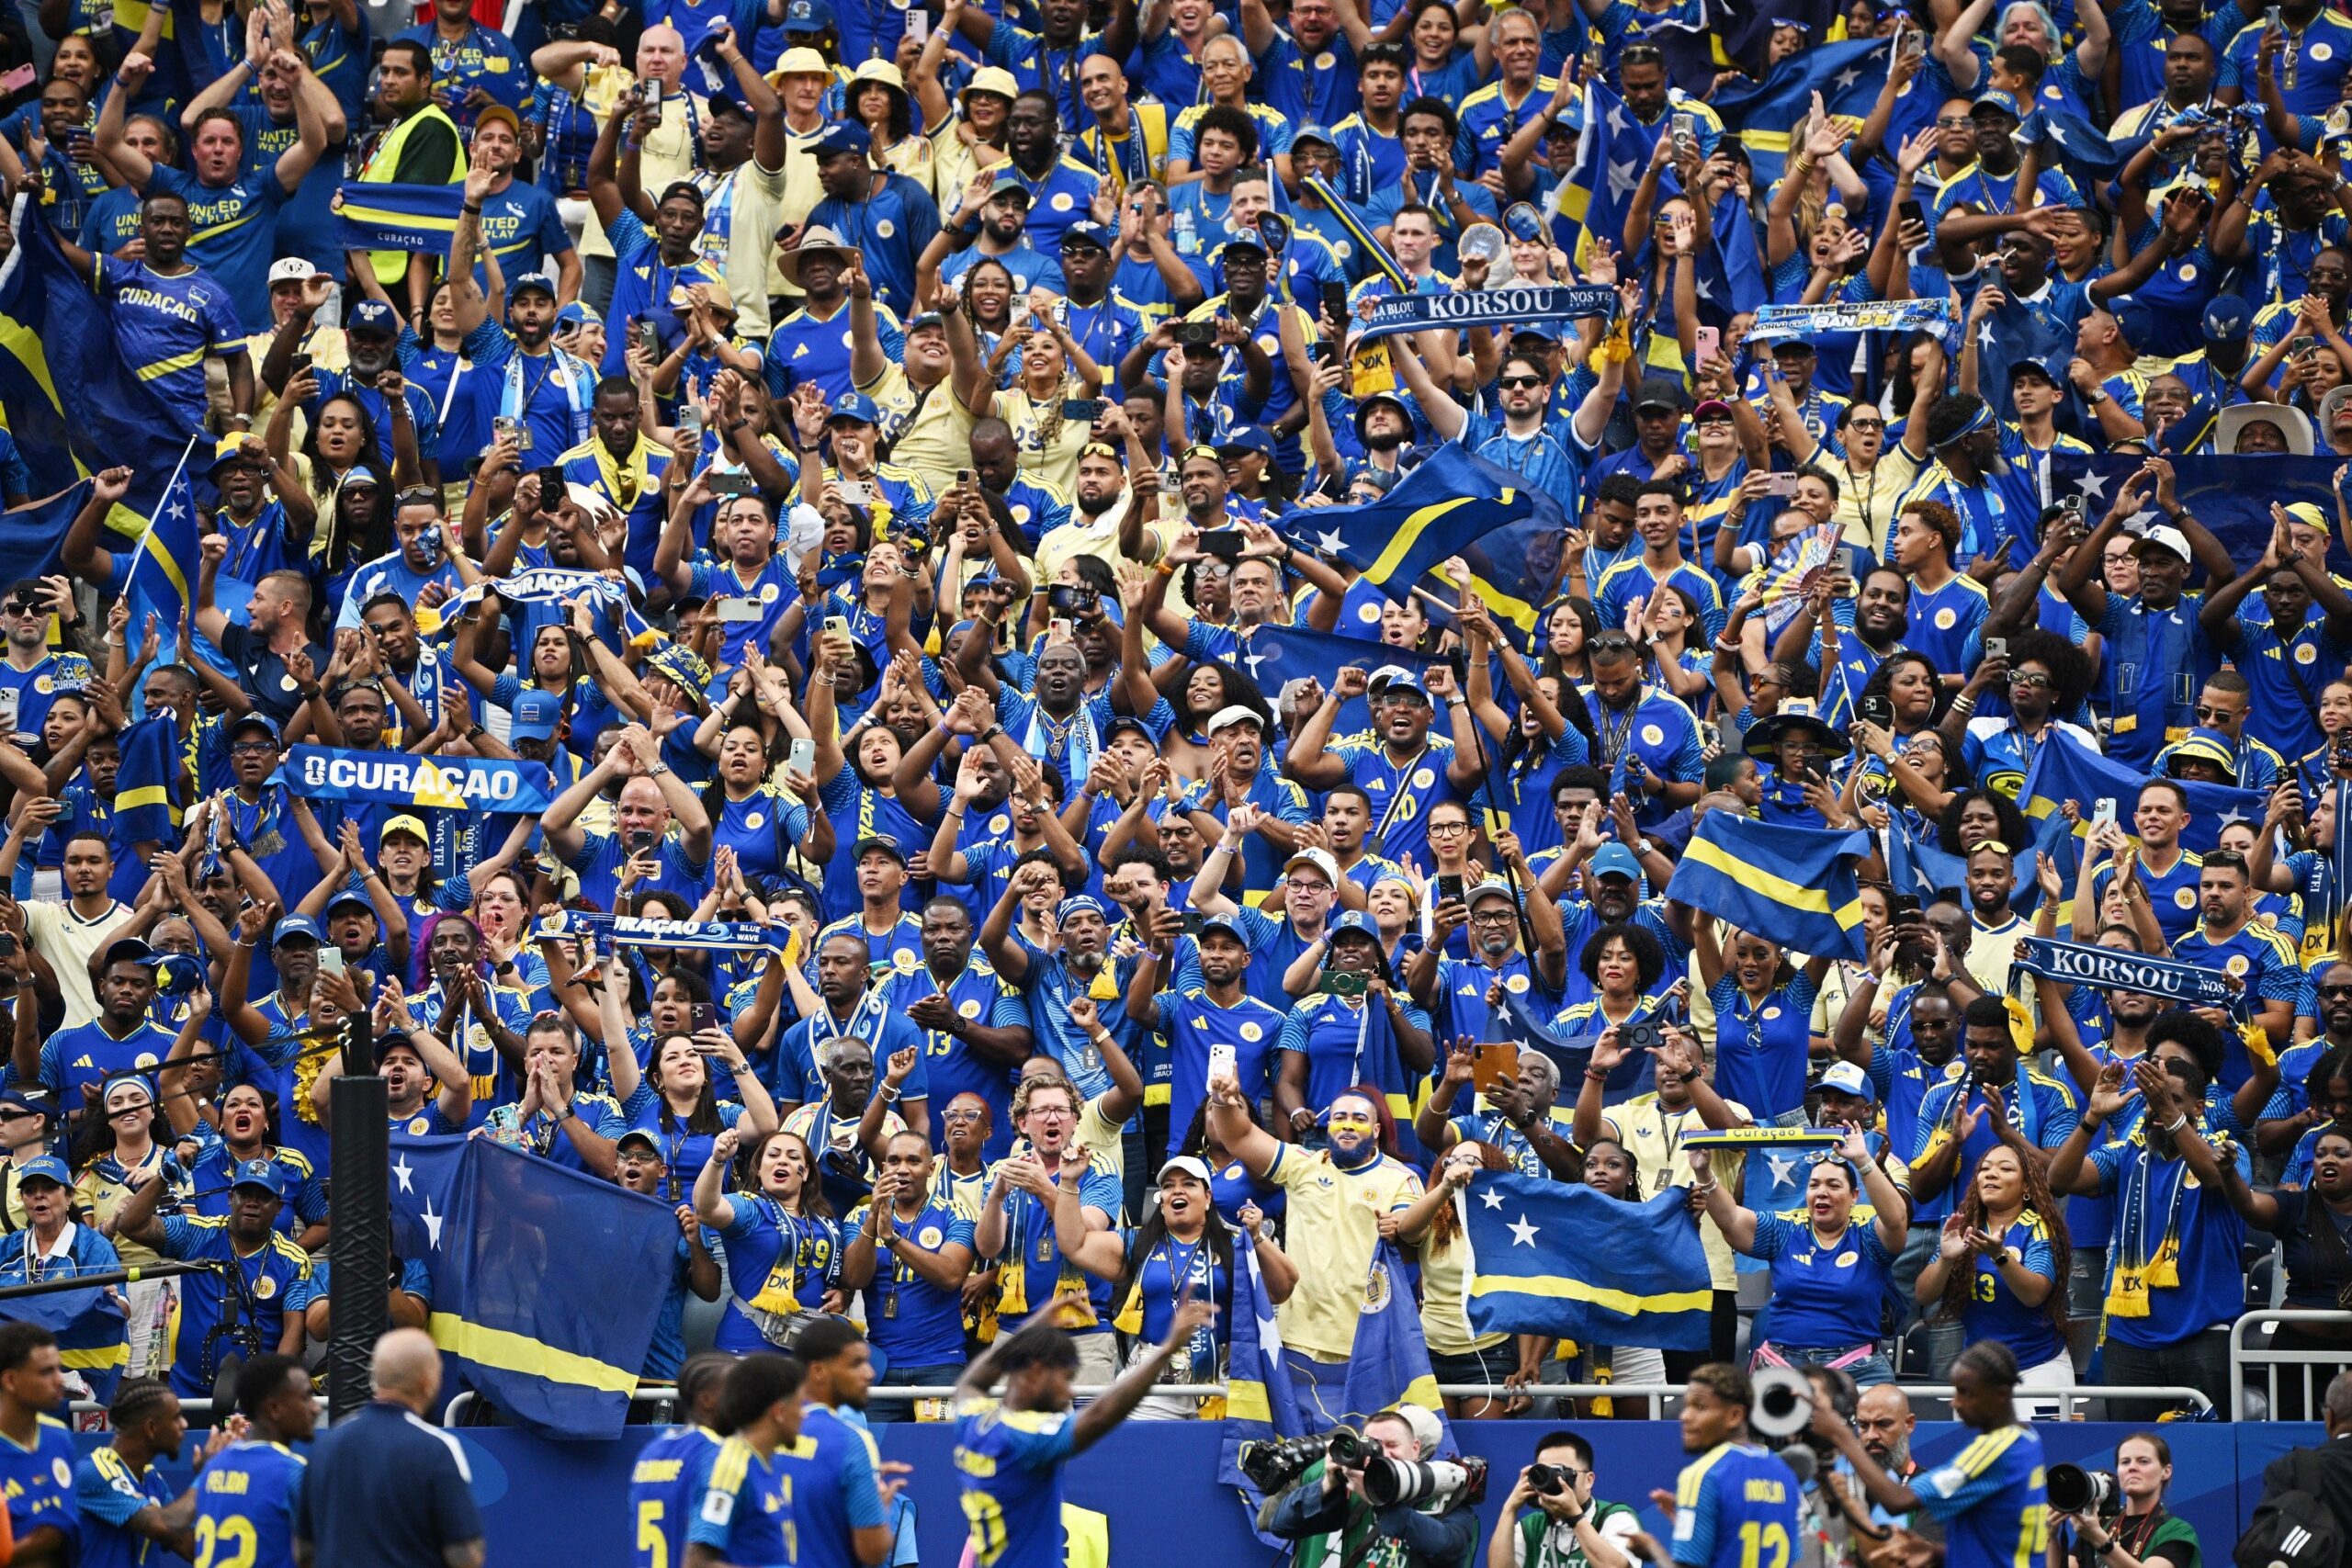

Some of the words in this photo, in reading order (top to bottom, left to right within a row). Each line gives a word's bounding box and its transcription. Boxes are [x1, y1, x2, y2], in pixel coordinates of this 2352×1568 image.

[208, 212, 239, 224] PLAY
[481, 217, 519, 230] ITED
[378, 231, 424, 245] CURAÇAO
[1426, 288, 1553, 319] KORSOU
[1570, 291, 1594, 302] NOS
[1386, 300, 1415, 314] BLOU
[1814, 314, 1856, 329] BAN
[1082, 714, 1092, 754] MUNDIAL
[329, 759, 517, 804] CURAÇAO
[435, 819, 445, 844] NOS
[434, 846, 445, 866] TEI
[614, 919, 700, 941] URAÇAO
[740, 924, 761, 933] BLUE
[737, 933, 759, 942] WAVE
[2052, 948, 2184, 992] KORSOU
[2199, 980, 2225, 994] NOS
[927, 1029, 951, 1055] 13
[1153, 1070, 1172, 1078] CURAÇA
[1734, 1128, 1796, 1140] Curaçao
[637, 1499, 669, 1568] 5
